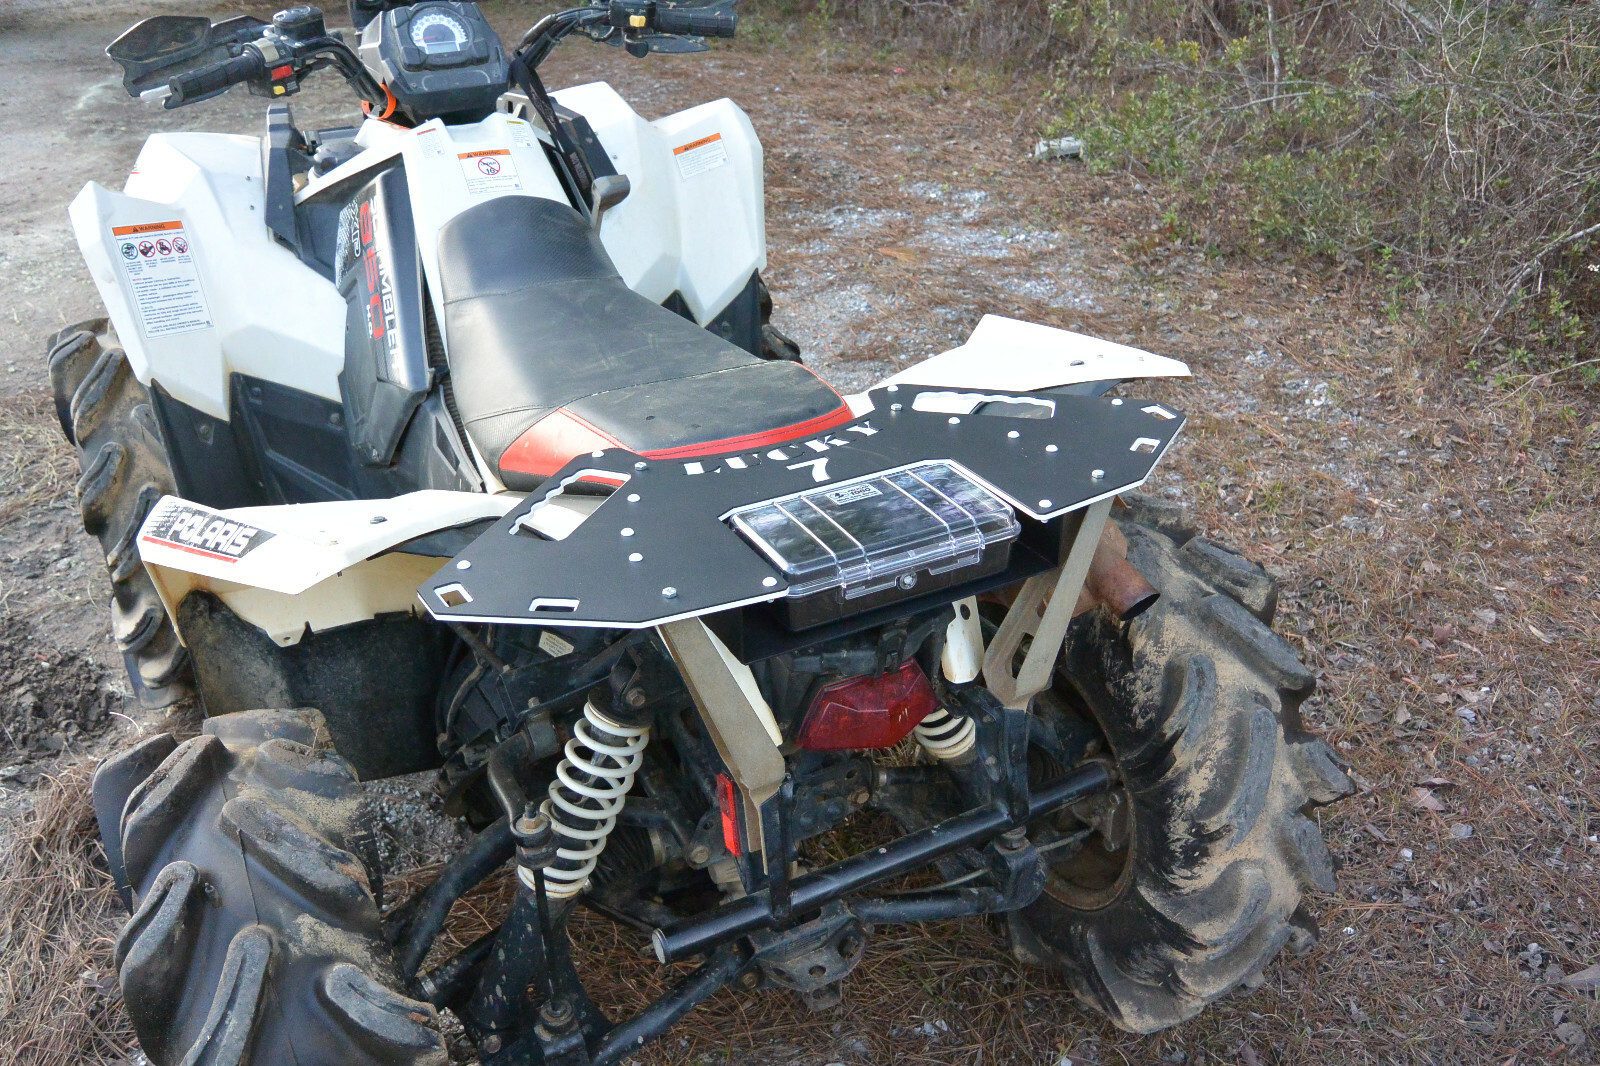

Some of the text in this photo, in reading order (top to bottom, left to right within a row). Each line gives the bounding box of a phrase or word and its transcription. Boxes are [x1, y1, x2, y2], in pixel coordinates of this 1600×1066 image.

[139, 224, 165, 232] WARNING
[360, 201, 384, 339] 850
[680, 419, 882, 475] LUCKY
[786, 456, 831, 482] 7
[167, 512, 259, 555] POLARIS
